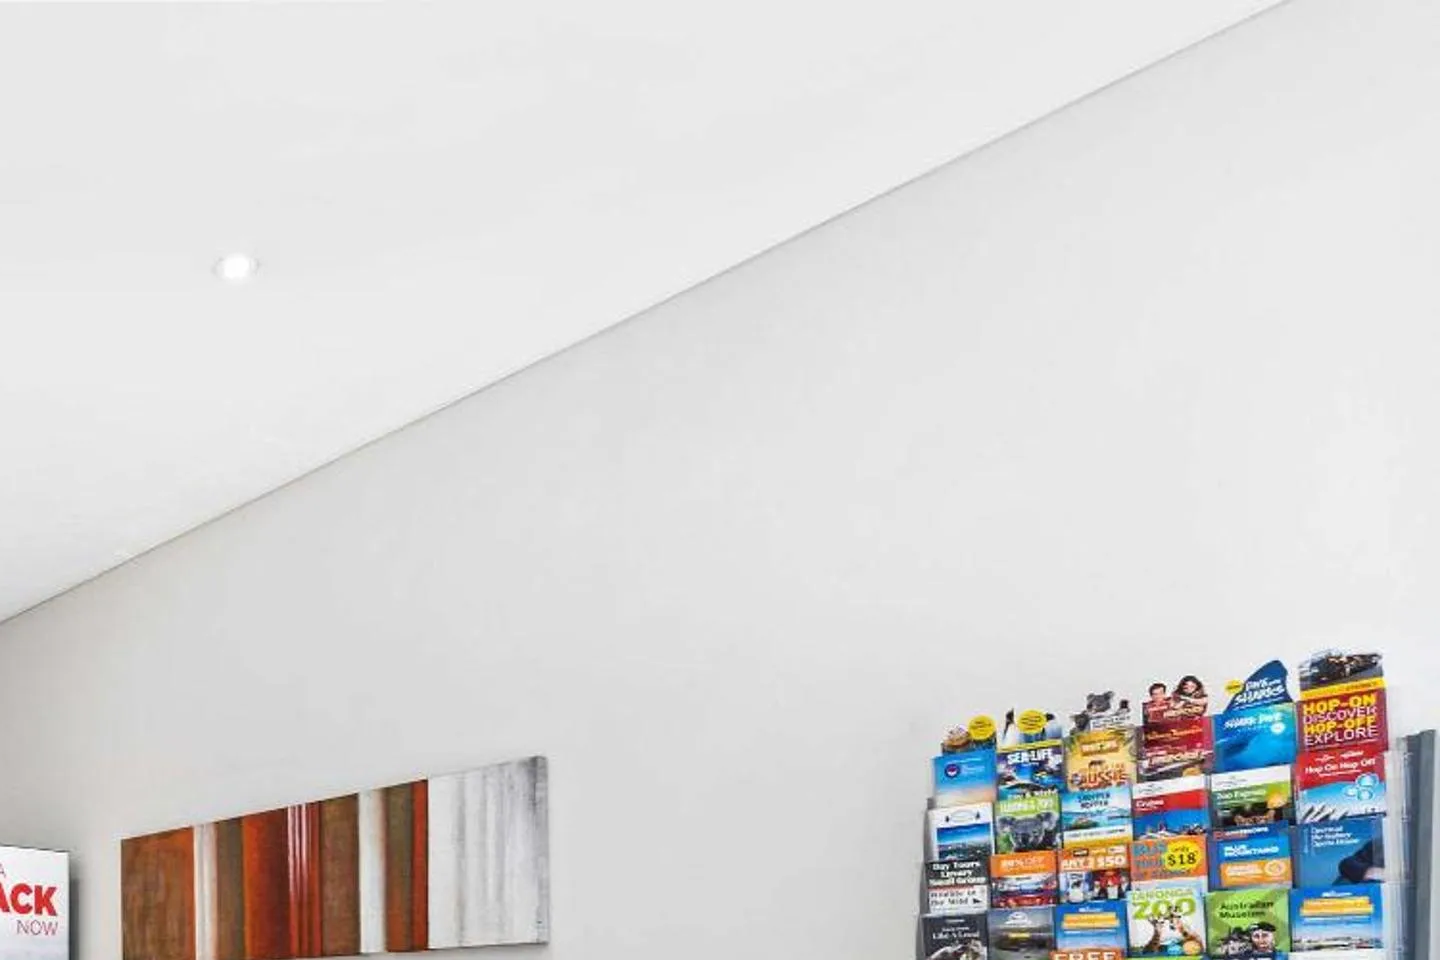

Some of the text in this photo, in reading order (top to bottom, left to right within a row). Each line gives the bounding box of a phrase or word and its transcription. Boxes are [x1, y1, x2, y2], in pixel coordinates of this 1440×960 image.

[1303, 694, 1376, 713] HOP-ON
[1303, 706, 1378, 725] DISCOVER
[1303, 716, 1377, 735] HOP-OFF
[1304, 726, 1379, 746] EXPLORE
[1167, 852, 1197, 866] $18
[1133, 897, 1197, 920] ZOO
[1220, 900, 1274, 911] Australian
[1220, 910, 1266, 919] Museum
[16, 919, 59, 936] NOW
